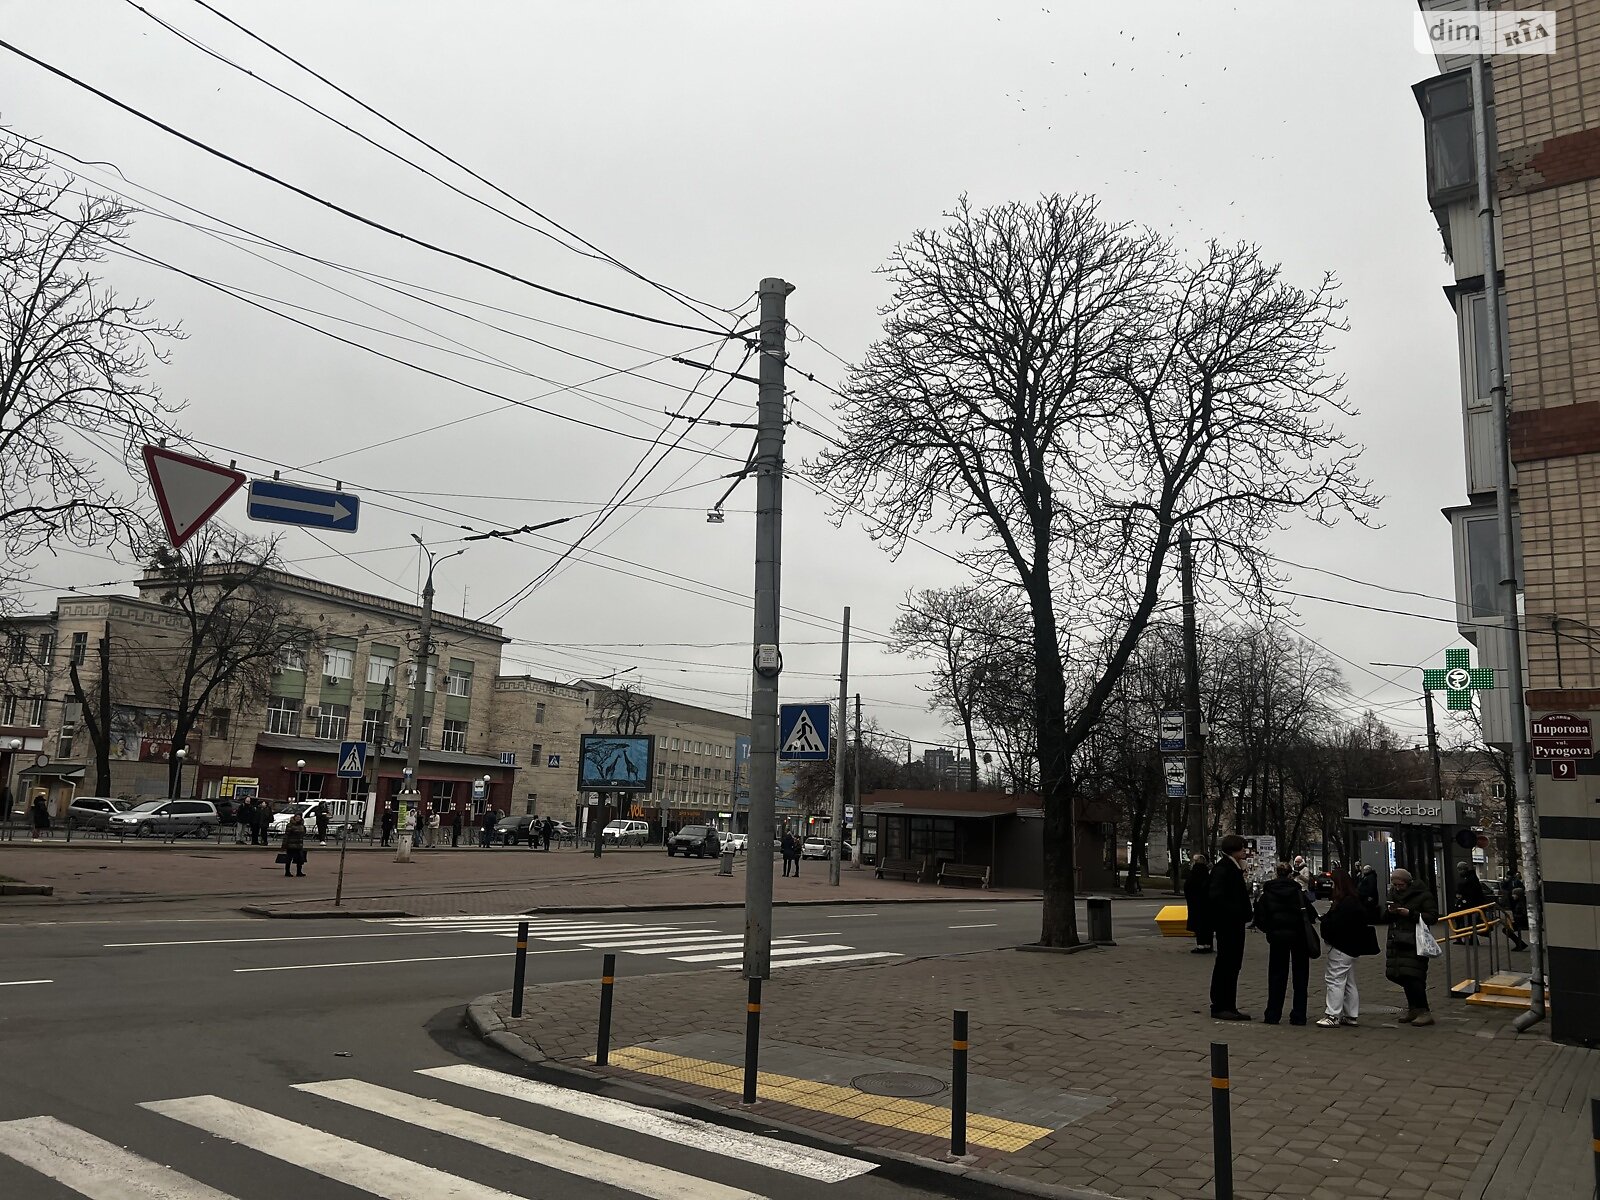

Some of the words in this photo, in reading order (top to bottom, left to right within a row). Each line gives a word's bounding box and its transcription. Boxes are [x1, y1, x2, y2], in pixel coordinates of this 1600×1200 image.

[1533, 723, 1589, 736] Пирогова
[1535, 746, 1591, 758] Pyrogova
[1559, 763, 1568, 776] 9
[1372, 803, 1412, 816] soska
[1417, 803, 1441, 817] bar
